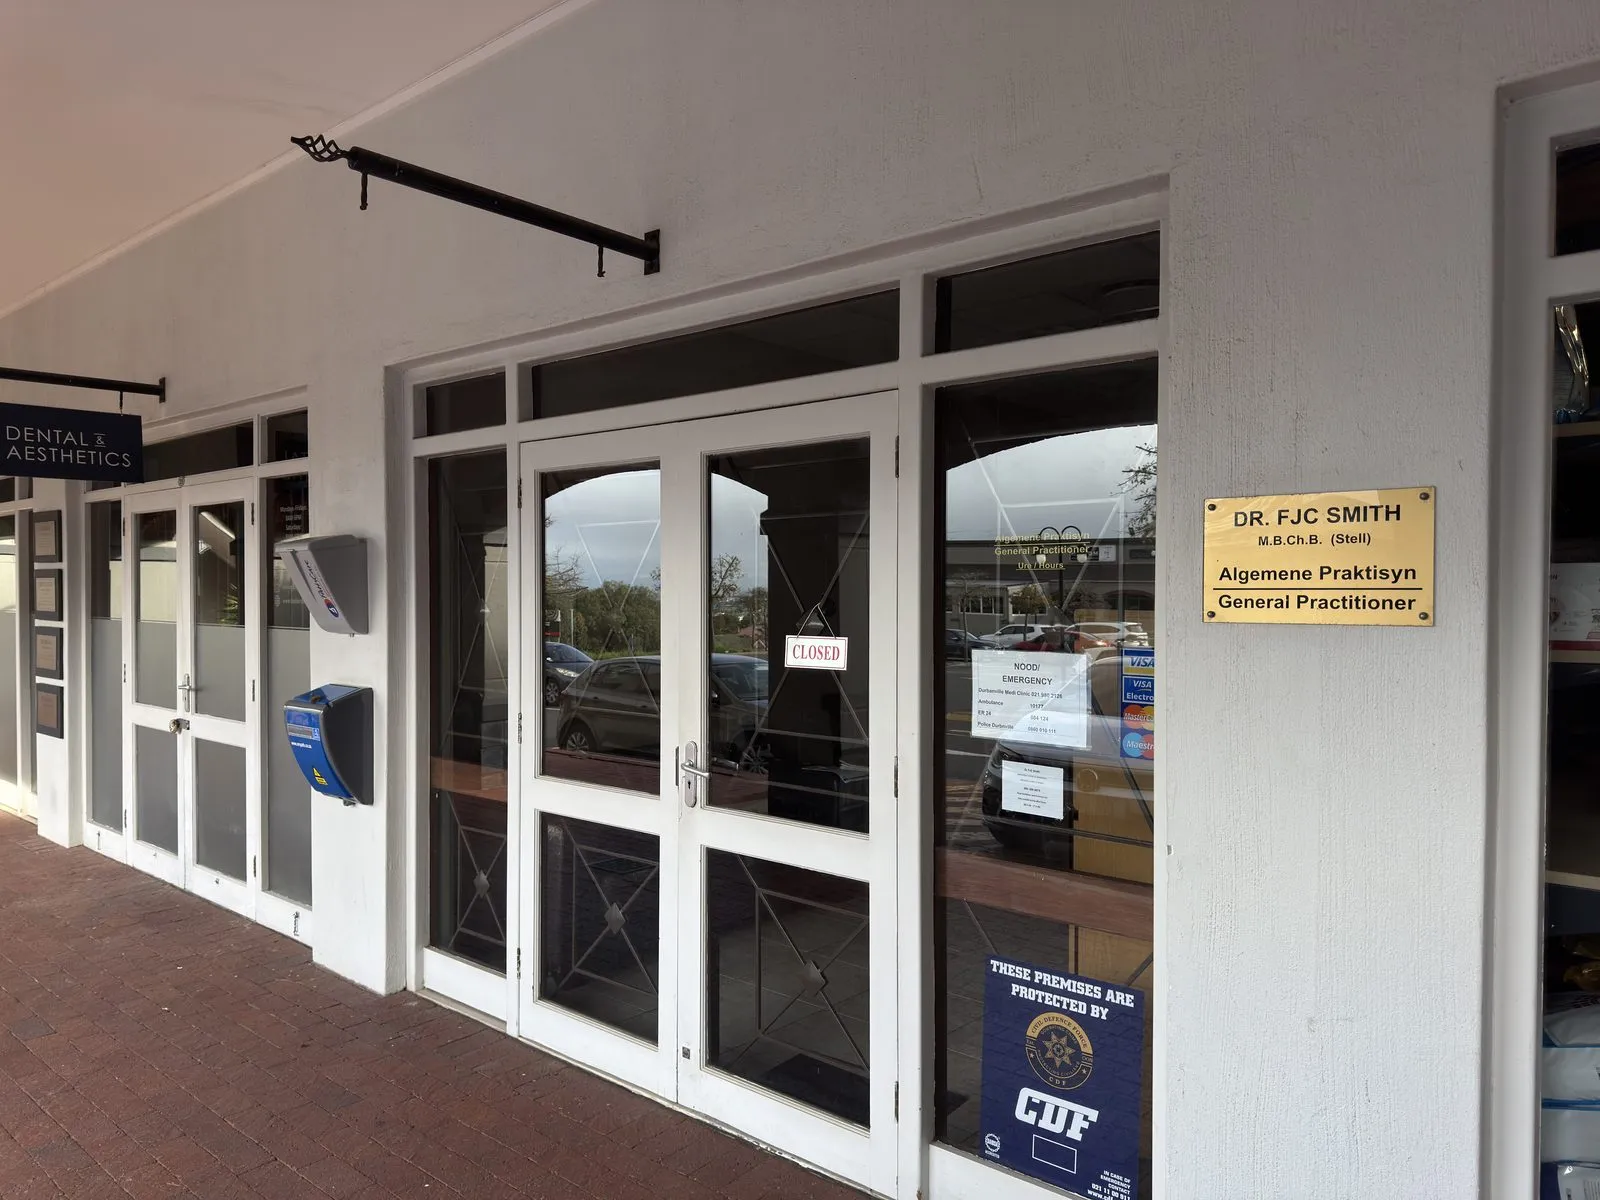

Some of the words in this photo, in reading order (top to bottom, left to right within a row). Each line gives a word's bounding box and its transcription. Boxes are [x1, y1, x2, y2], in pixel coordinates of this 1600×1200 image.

[6, 425, 89, 446] DENTAL
[6, 445, 131, 468] AESTHETICS
[1234, 510, 1269, 527] DR.
[1277, 508, 1319, 525] FJC
[1326, 504, 1401, 523] SMITH
[994, 534, 1041, 544] Algemene
[1043, 532, 1090, 542] Praktisyn
[1258, 534, 1322, 546] M.B.Ch.B.
[1330, 533, 1371, 547] (Stell)
[994, 547, 1030, 556] General
[1032, 545, 1089, 555] Practitioner
[1218, 567, 1312, 584] Algemene
[1319, 565, 1417, 584] Praktisyn
[1218, 594, 1290, 609] General
[1296, 594, 1417, 610] Practitioner
[792, 644, 840, 661] CLOSED
[1014, 662, 1041, 671] NOOD/
[1129, 656, 1155, 667] VISA
[1002, 675, 1053, 685] EMERGENCY
[1133, 680, 1152, 688] VISA
[990, 959, 1031, 981] THESE
[1034, 970, 1101, 999] PREMISES
[1105, 989, 1135, 1008] ARE
[1011, 983, 1087, 1015] PROTECTED
[1090, 1004, 1109, 1021] BY
[1031, 1019, 1044, 1034] CIVIL
[1043, 1016, 1072, 1028] DEFENCE
[1072, 1026, 1088, 1049] FORCE
[1014, 1087, 1099, 1141] CDF
[1100, 1174, 1131, 1189] EMERGENCY
[1110, 1172, 1124, 1181] CASE
[1091, 1183, 1102, 1191] 021
[1108, 1183, 1130, 1195] CONTACT
